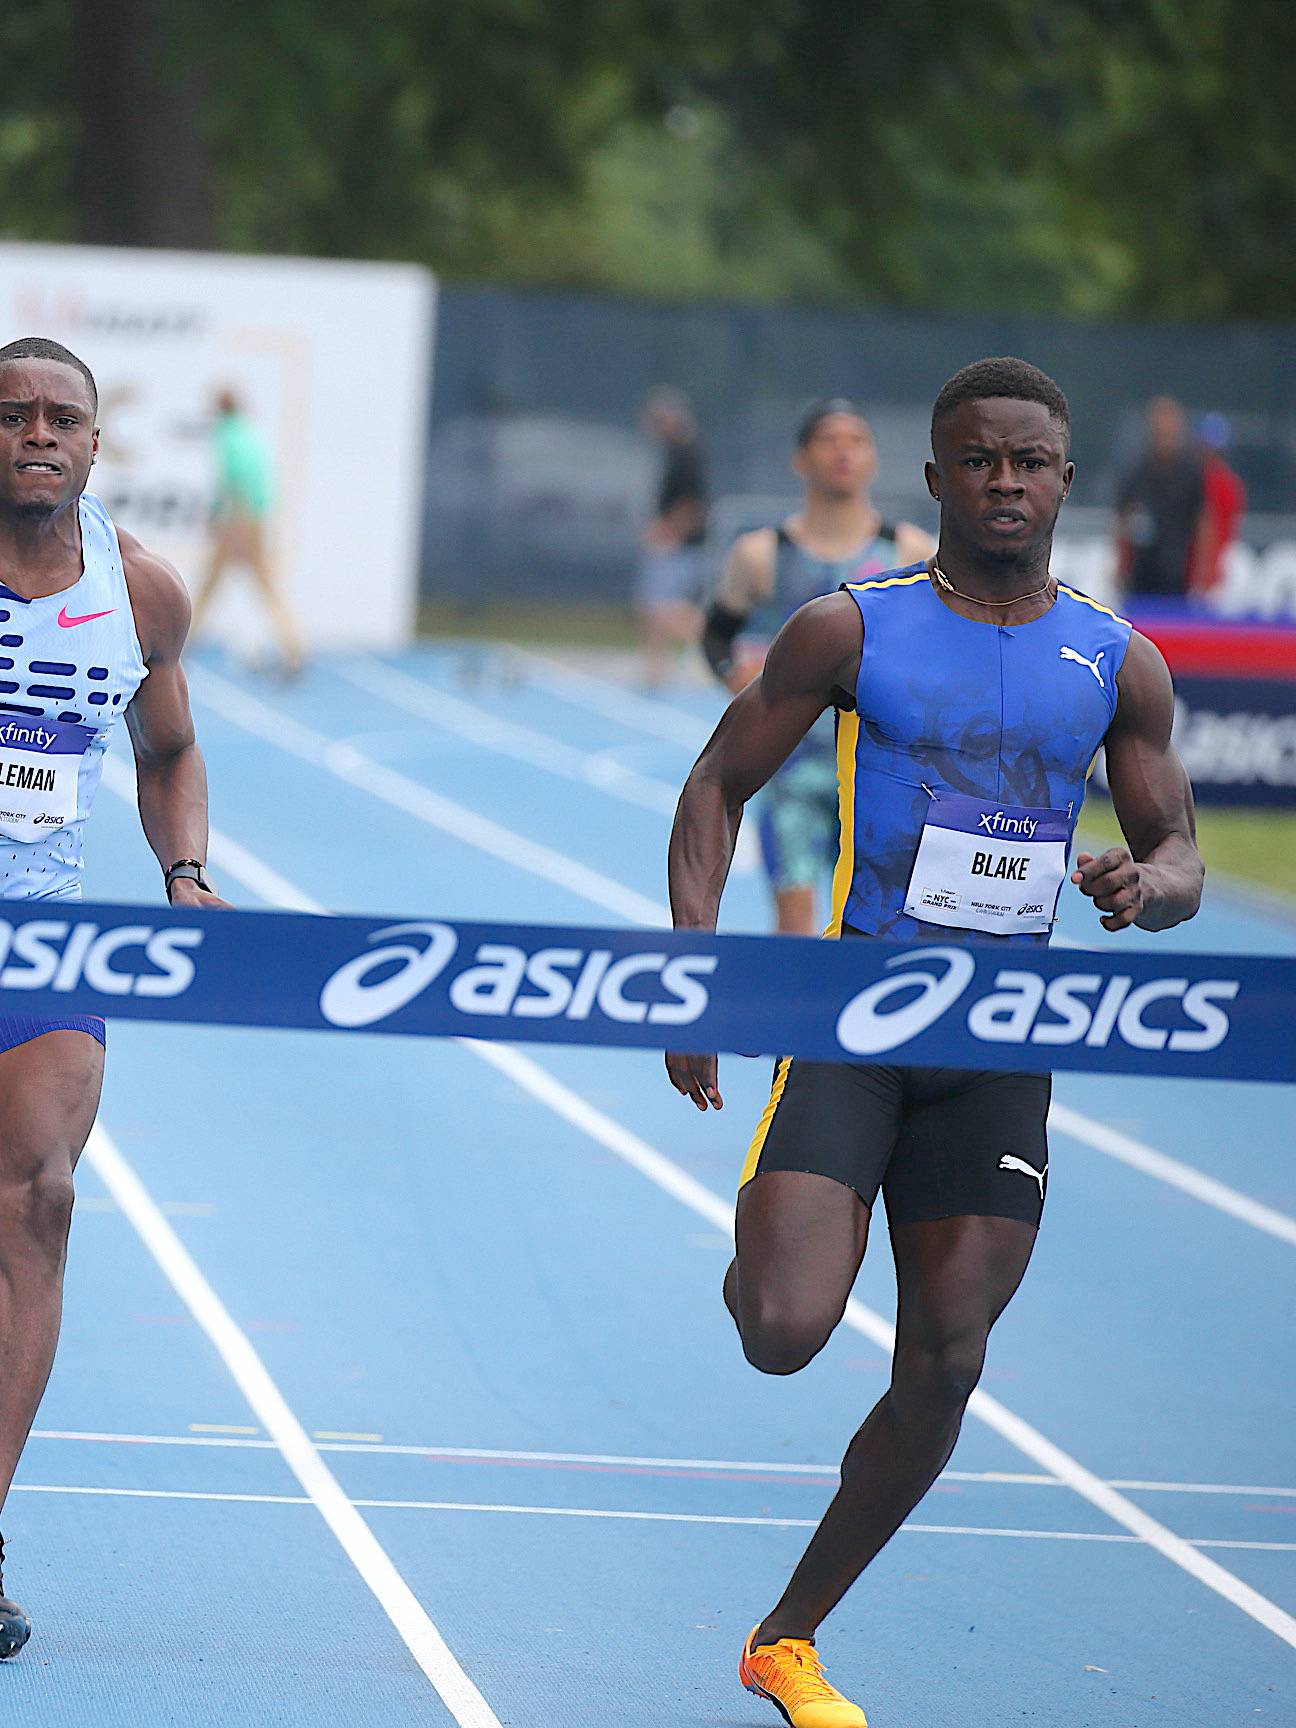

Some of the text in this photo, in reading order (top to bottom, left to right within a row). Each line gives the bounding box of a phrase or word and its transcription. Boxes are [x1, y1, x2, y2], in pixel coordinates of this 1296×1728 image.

[977, 811, 1039, 839] xfinity
[970, 851, 1031, 881] BLAKE
[449, 945, 718, 1026] asics
[968, 971, 1240, 1051] asics
